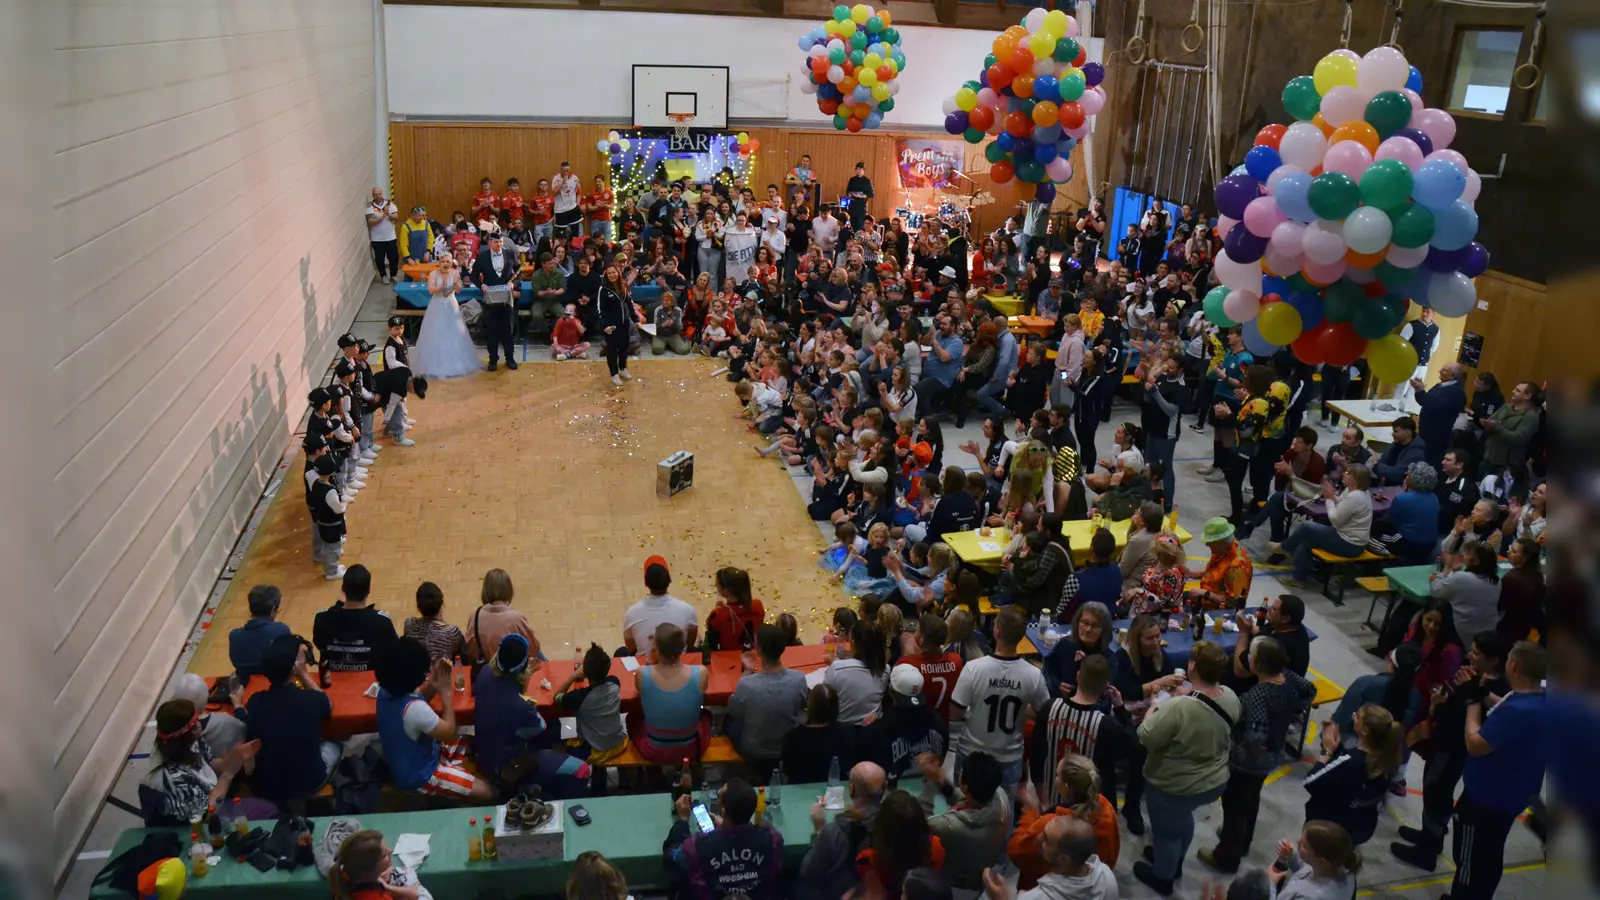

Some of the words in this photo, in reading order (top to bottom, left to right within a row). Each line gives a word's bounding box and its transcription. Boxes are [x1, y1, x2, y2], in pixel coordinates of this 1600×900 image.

[669, 133, 710, 151] BAR
[901, 148, 935, 165] Prem
[915, 162, 945, 179] Boys
[920, 661, 956, 674] RONALDO
[989, 677, 1021, 690] MUSIALA
[931, 676, 948, 709] 7
[983, 694, 1023, 736] 10
[710, 848, 765, 870] SALON
[730, 863, 745, 873] BAD
[718, 871, 759, 883] WINDSHEIM
